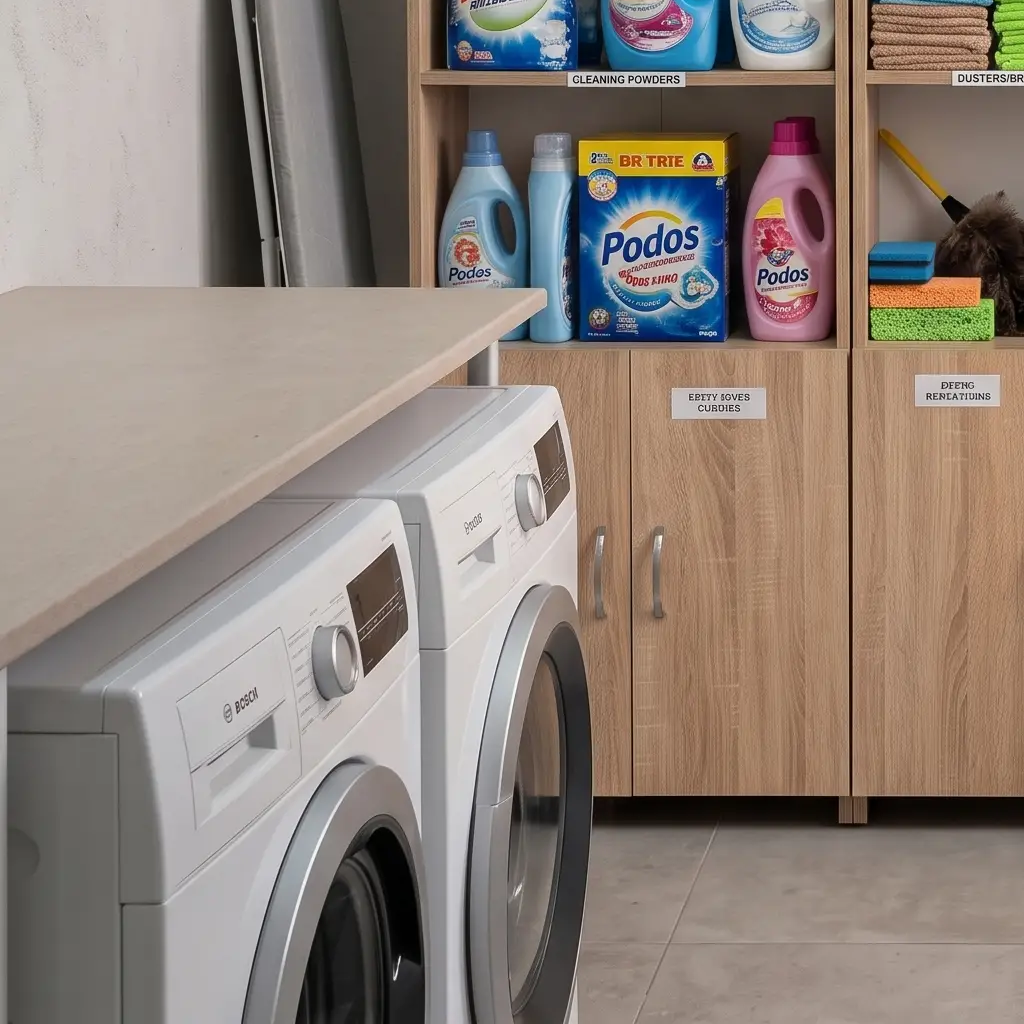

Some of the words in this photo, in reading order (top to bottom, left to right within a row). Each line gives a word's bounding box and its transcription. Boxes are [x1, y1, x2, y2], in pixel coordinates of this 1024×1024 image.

[572, 75, 625, 84] CLEANING
[628, 75, 680, 84] POWDERS
[645, 154, 685, 168] TRIE
[601, 222, 700, 267] Podos
[448, 266, 492, 282] Podos
[757, 265, 809, 286] Podos
[234, 686, 259, 715] BOSCH
